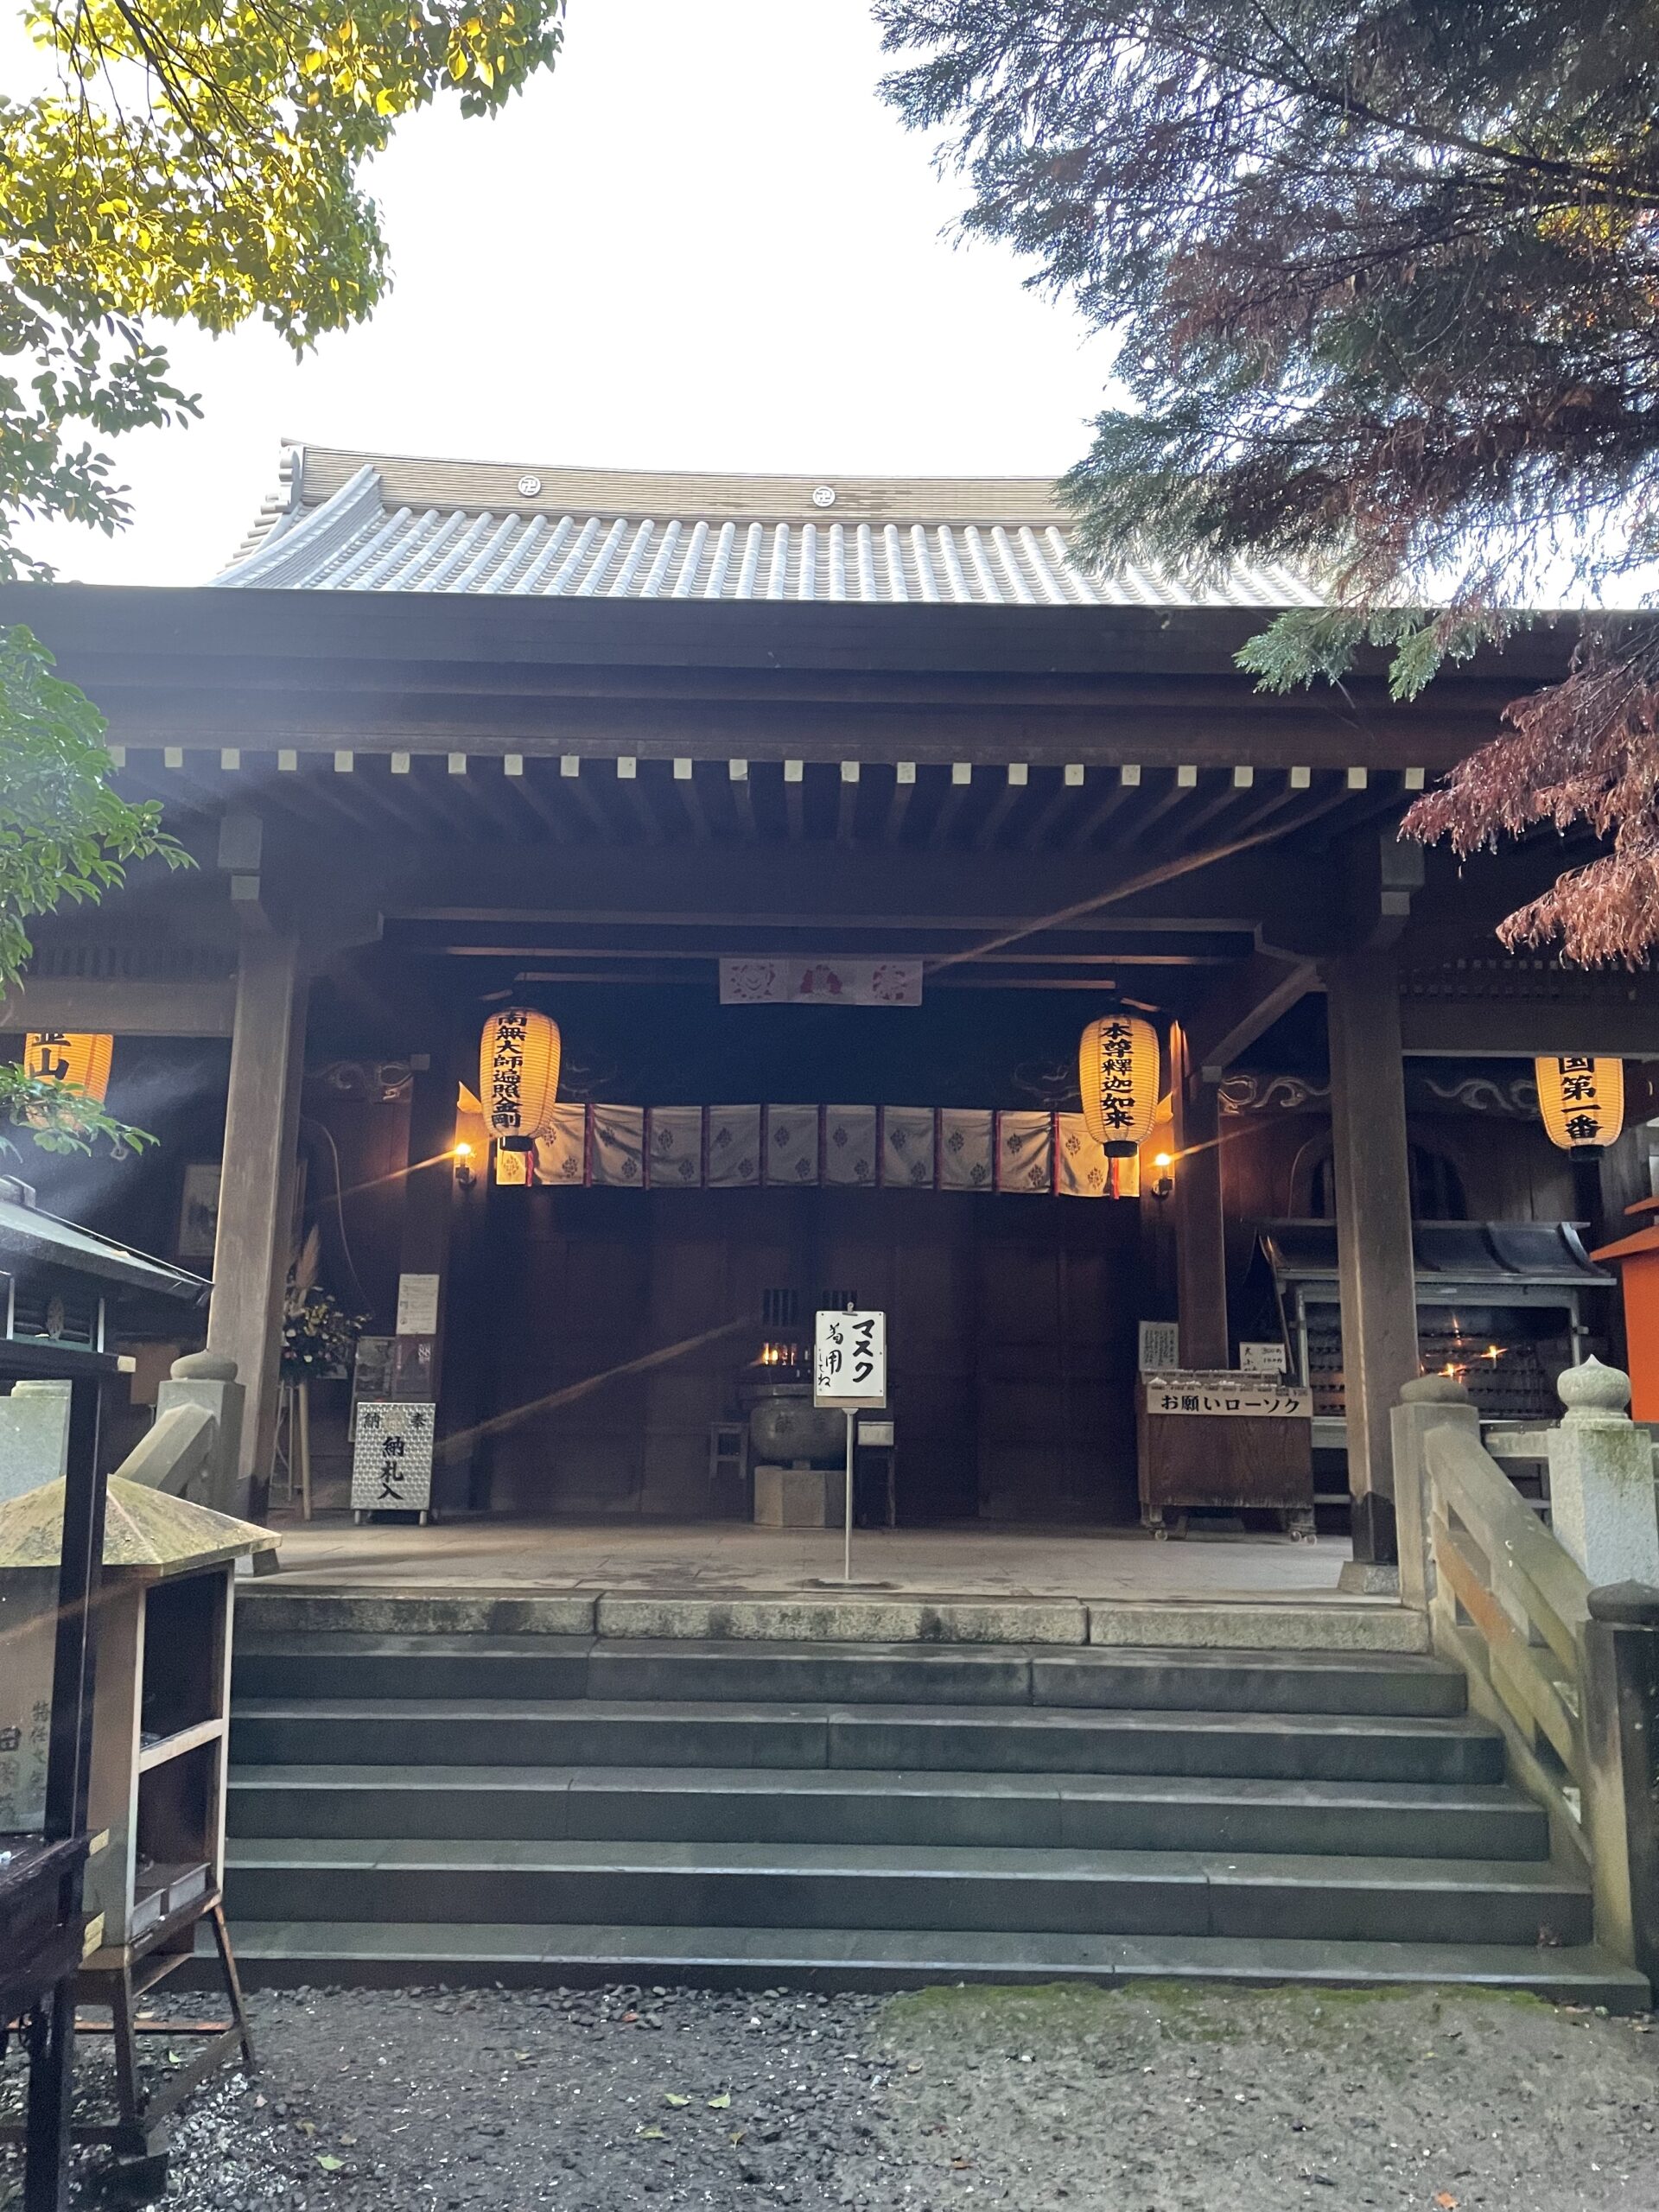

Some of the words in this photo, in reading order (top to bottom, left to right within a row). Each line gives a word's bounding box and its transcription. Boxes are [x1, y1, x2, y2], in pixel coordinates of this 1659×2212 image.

[492, 1011, 528, 1128] 南無大師遍照金剛
[817, 1352, 830, 1388] してね
[852, 1319, 874, 1383] マスク
[1161, 1395, 1300, 1414] お願いローソク
[377, 1435, 405, 1501] 納札入
